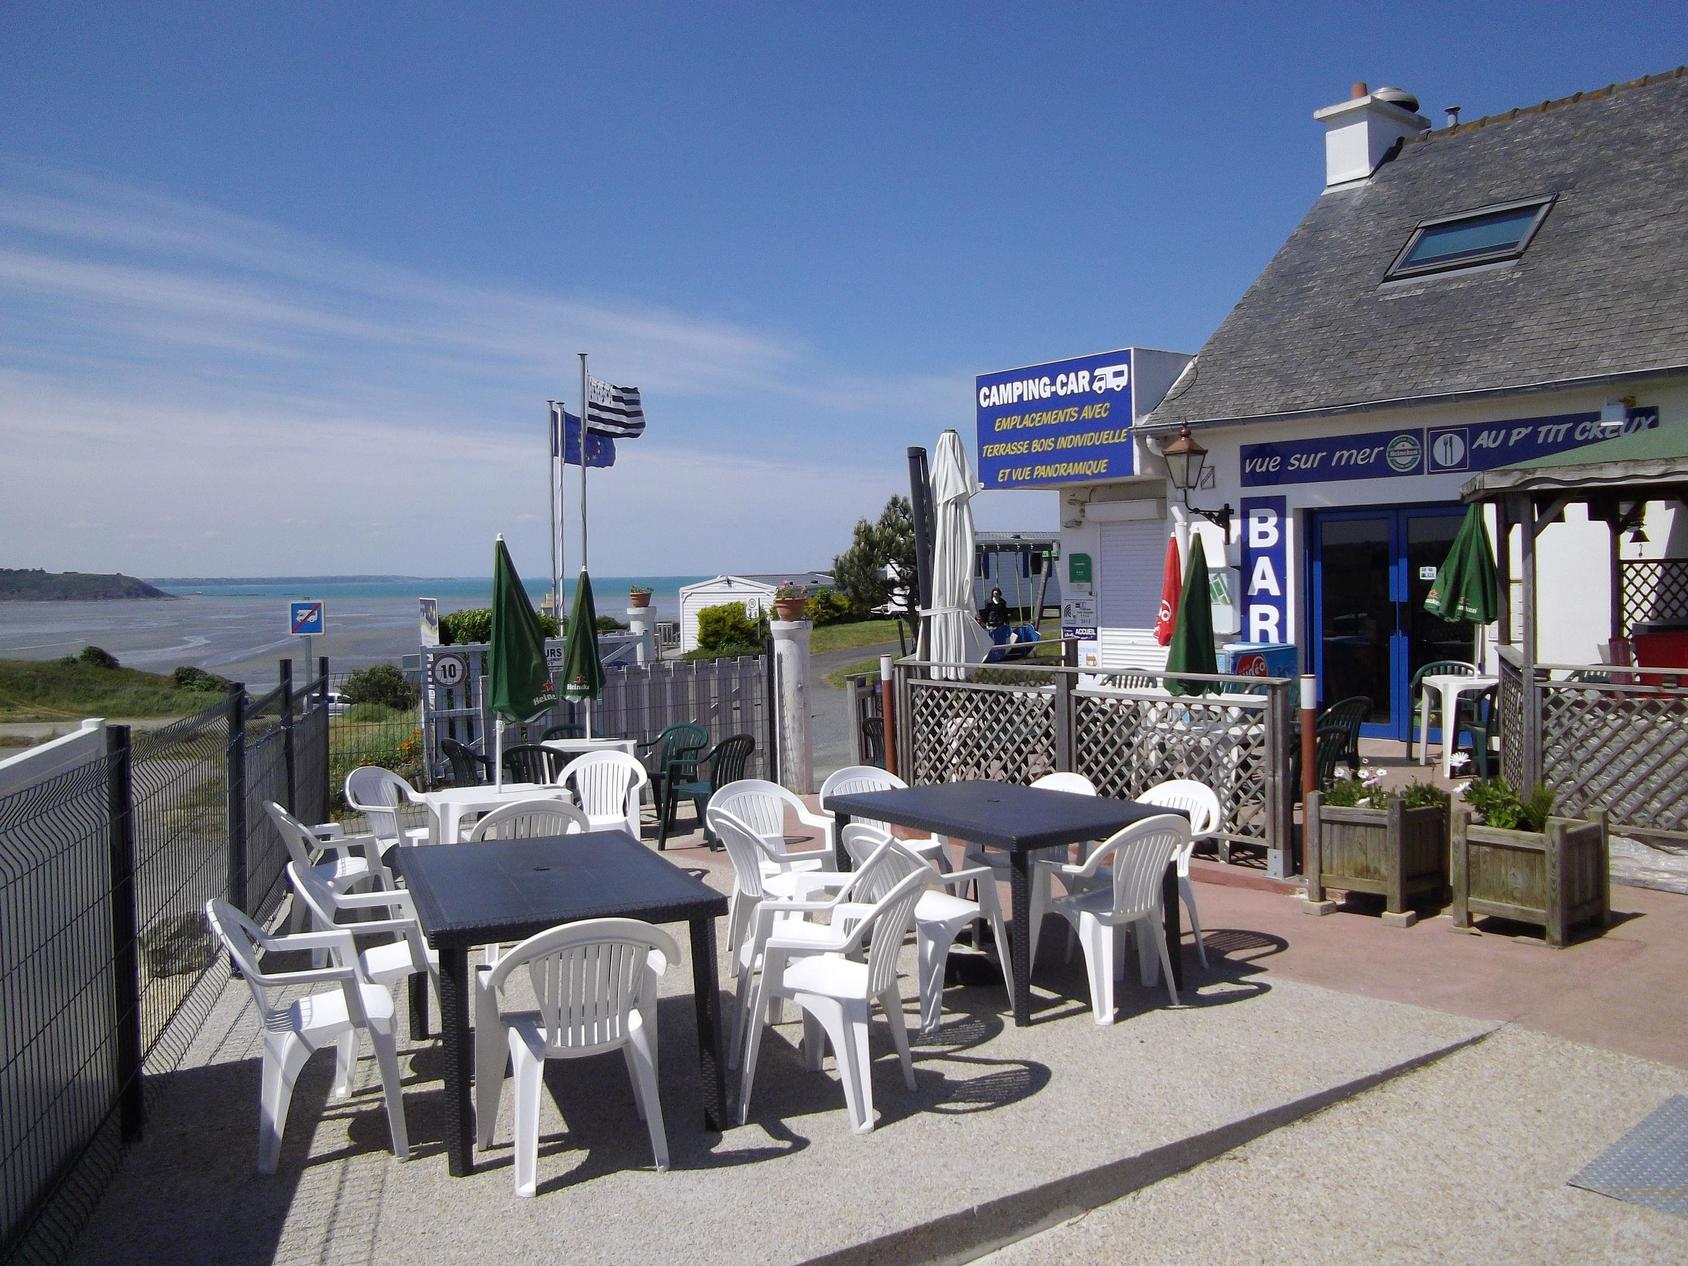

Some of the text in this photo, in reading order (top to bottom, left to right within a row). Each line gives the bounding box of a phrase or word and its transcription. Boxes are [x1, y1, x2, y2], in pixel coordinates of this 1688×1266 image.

[979, 370, 1090, 408] CAMPING-CAR
[994, 402, 1111, 432] EMPLACEMENTS AVEC
[982, 429, 1129, 458] TERRASSE BOIS INDIVIDUELLE
[1471, 429, 1506, 450] AU
[1537, 422, 1574, 444] TIT
[998, 459, 1109, 483] ET VUE PANORAMIQUE
[1245, 455, 1281, 473] vue
[1287, 451, 1327, 471] sur
[1331, 446, 1385, 467] mer
[1247, 508, 1281, 643] BAR
[441, 663, 457, 679] 10
